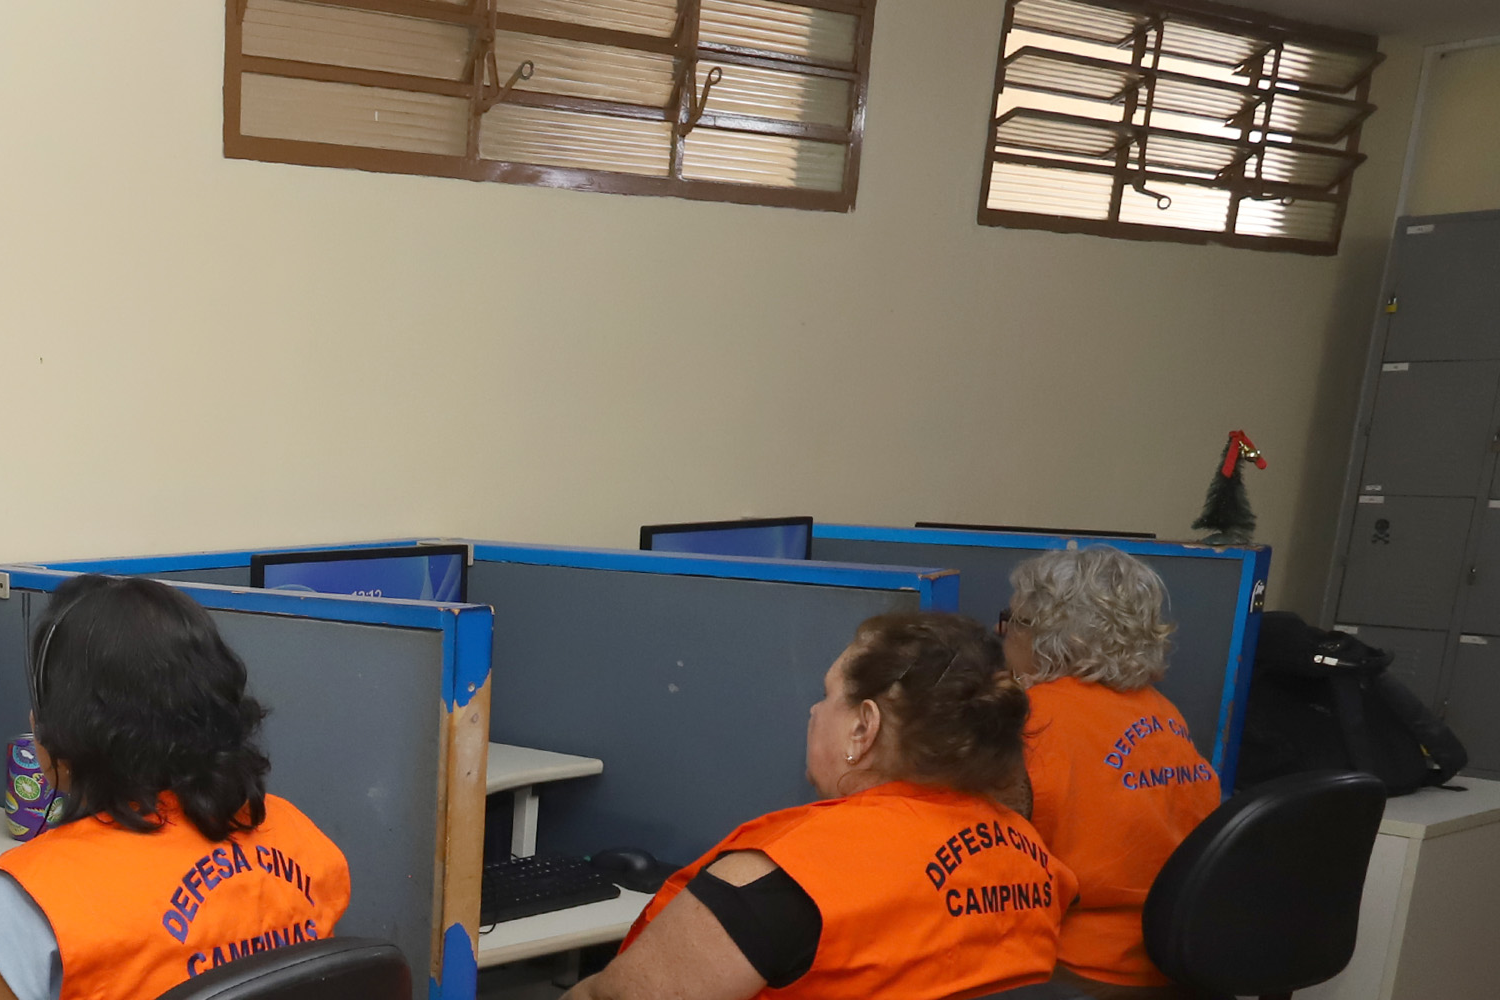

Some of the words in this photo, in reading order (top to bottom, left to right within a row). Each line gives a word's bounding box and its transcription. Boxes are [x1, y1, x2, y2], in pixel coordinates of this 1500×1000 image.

[1103, 715, 1163, 770] DEFESA
[1122, 764, 1212, 790] CAMPINAS
[925, 820, 1008, 891] DEFESA
[162, 842, 252, 944] DEFESA
[255, 845, 315, 907] CIVIL
[945, 881, 1052, 917] CAMPINAS
